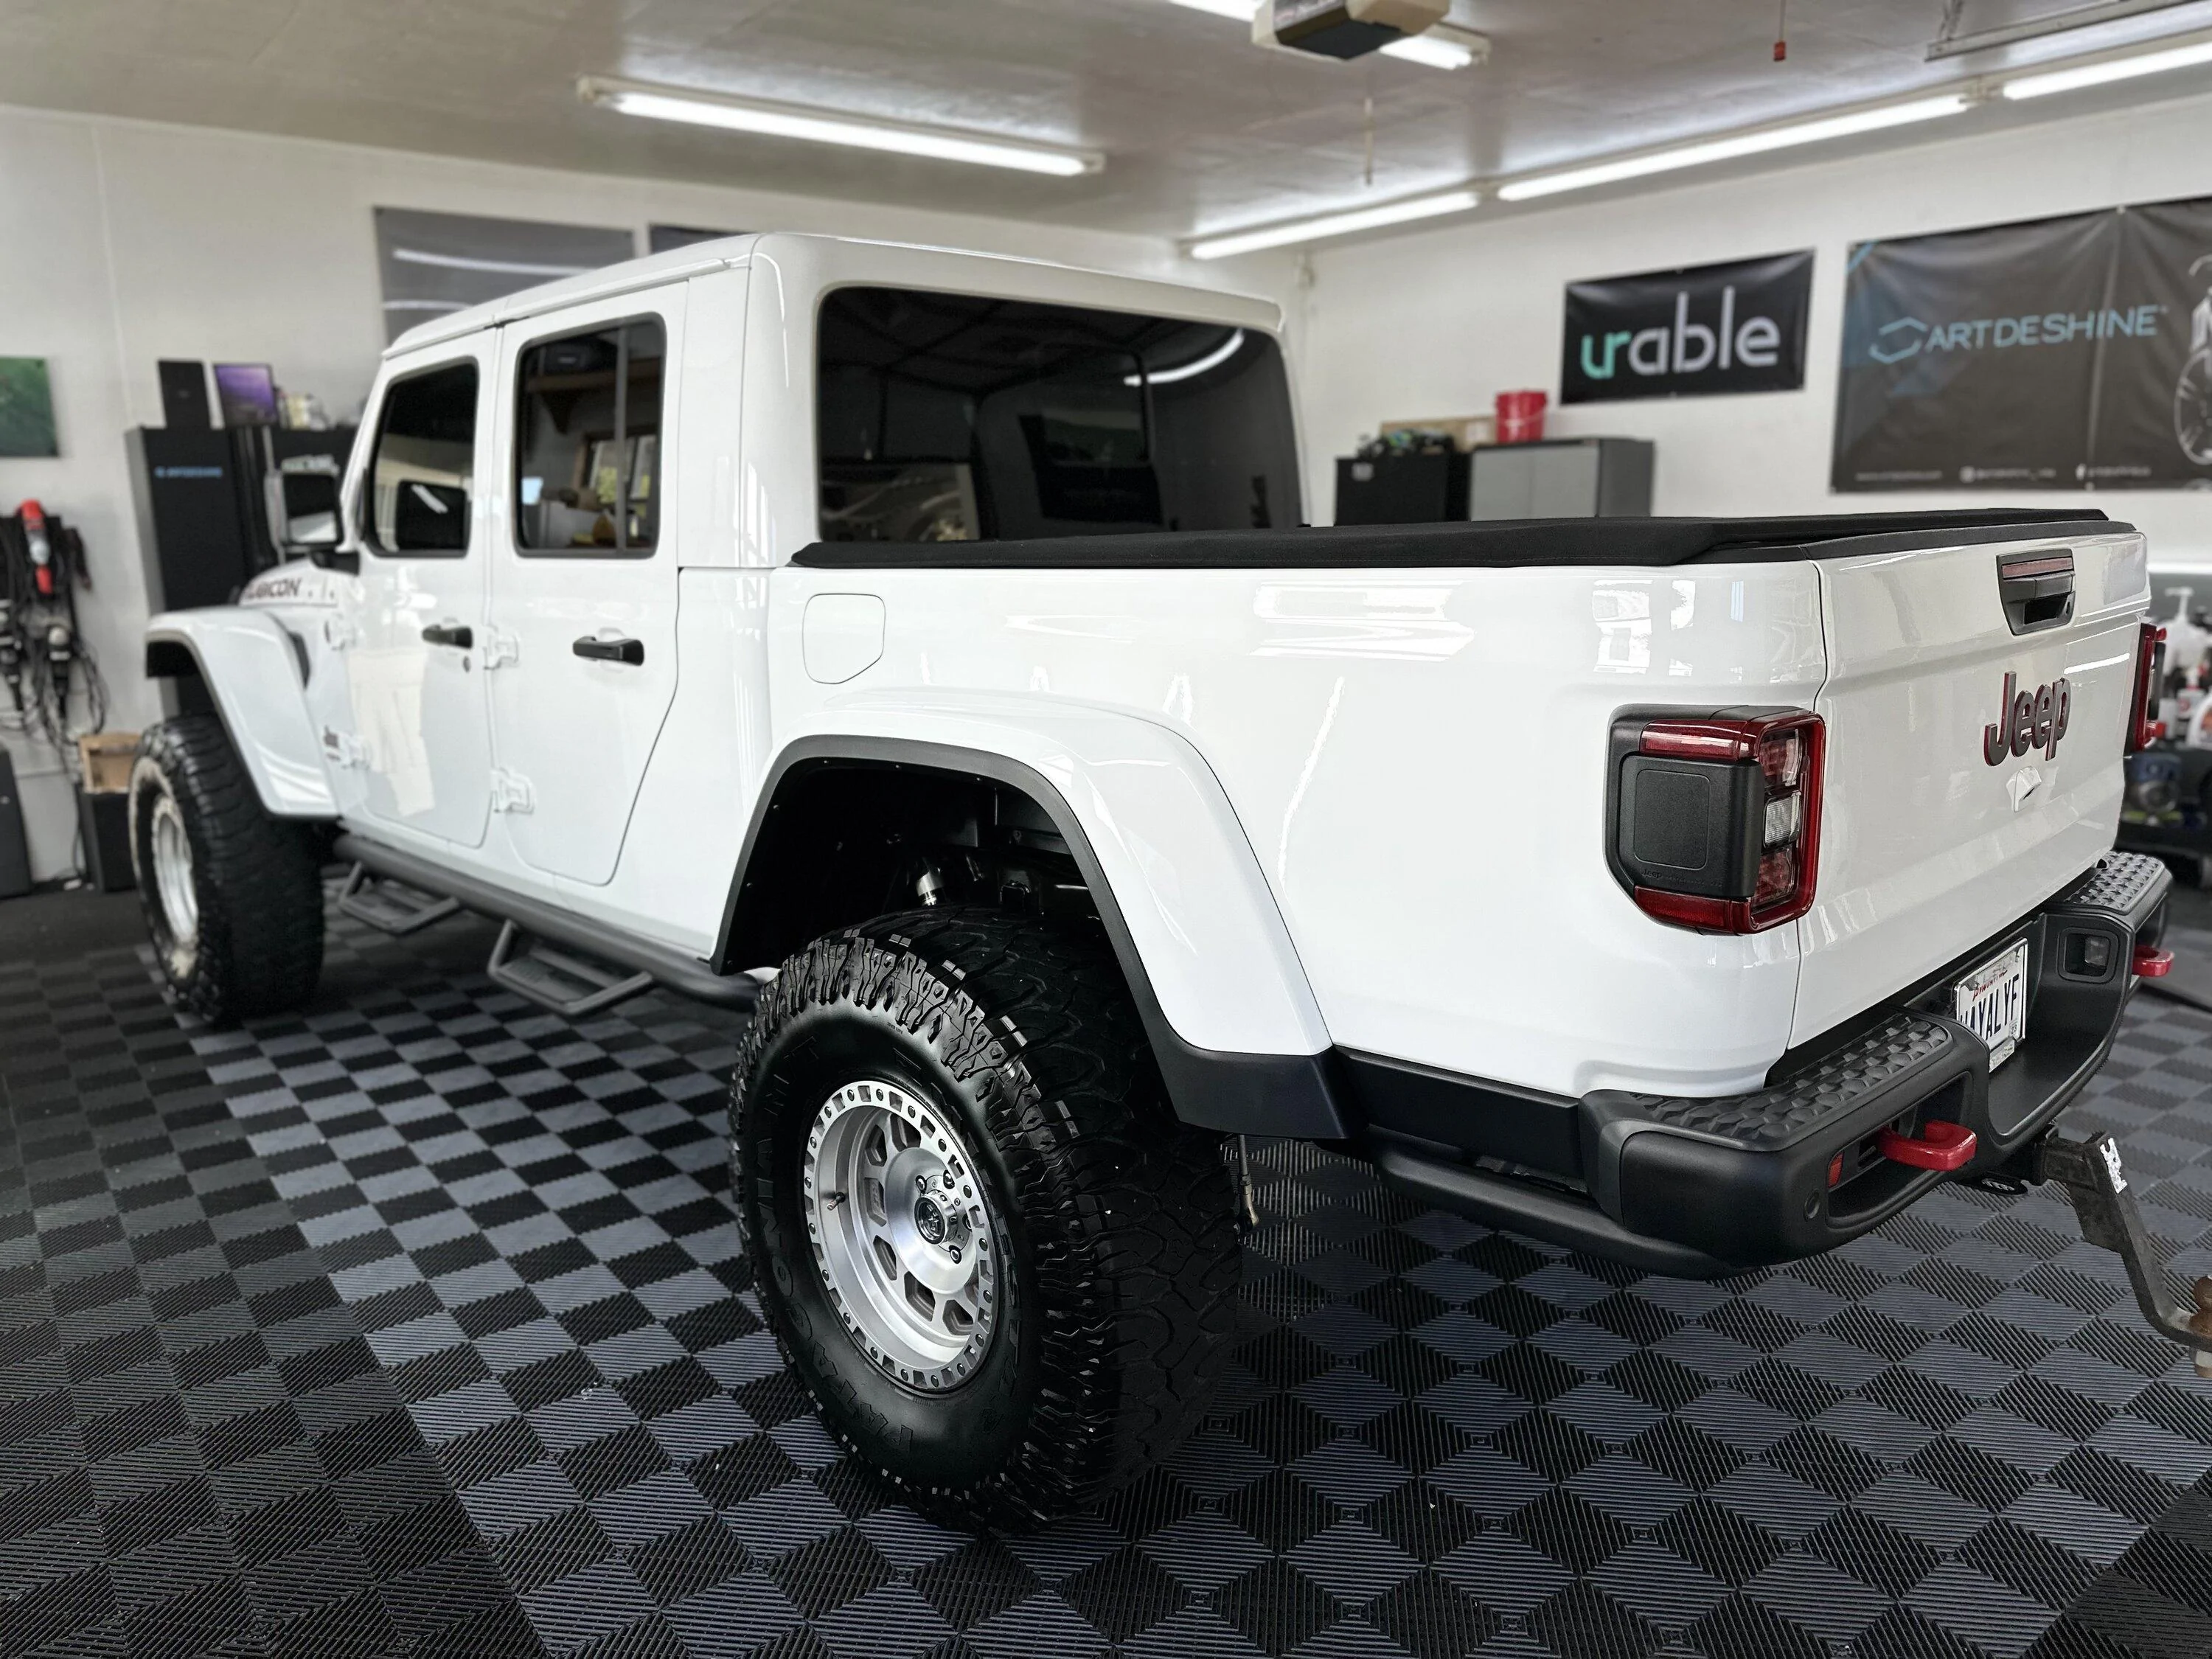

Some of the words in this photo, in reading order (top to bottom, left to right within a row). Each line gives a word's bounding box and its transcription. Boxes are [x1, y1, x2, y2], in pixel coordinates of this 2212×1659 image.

[1580, 285, 1781, 378] urable
[1983, 670, 2070, 767] Jeep
[1960, 973, 2019, 1041] AYALYF
